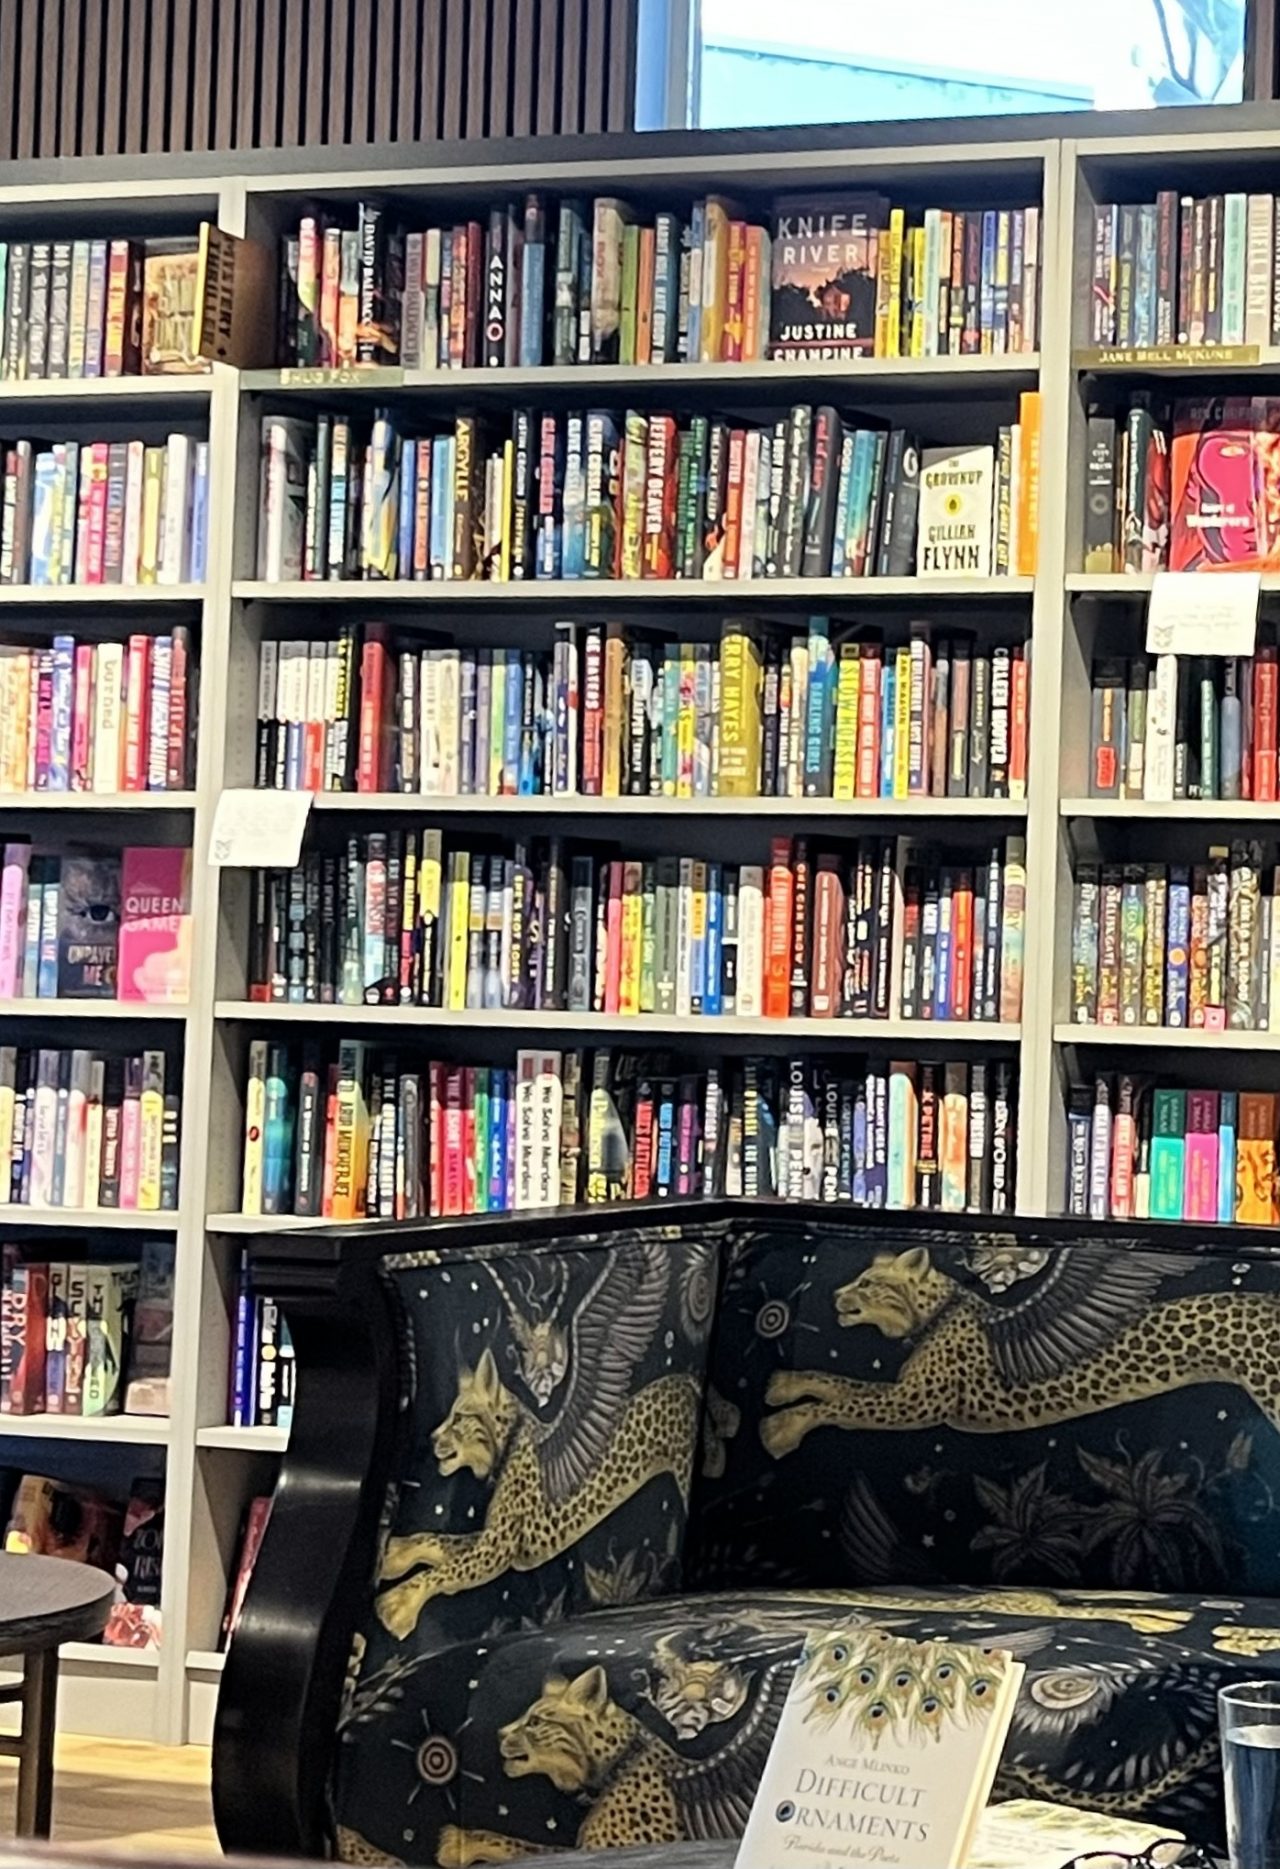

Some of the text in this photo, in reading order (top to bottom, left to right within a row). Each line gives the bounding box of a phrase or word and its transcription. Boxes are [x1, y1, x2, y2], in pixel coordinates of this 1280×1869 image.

[363, 224, 376, 266] DAVID
[778, 215, 869, 240] KNIFE
[655, 218, 670, 310] RABBIT HOLE KATE
[783, 246, 859, 265] RIVER
[1248, 226, 1266, 316] HELL BENT
[204, 243, 222, 346] THRILLER
[219, 238, 236, 338] MYSTERY
[780, 323, 858, 340] JUSTINE
[1098, 351, 1132, 363] JANE
[541, 417, 555, 455] CLIVE
[567, 419, 581, 452] CLIVE
[588, 419, 602, 452] CLIVE
[455, 419, 469, 502] ARGYLLE
[646, 416, 665, 534] JEFFERY DEAVER
[842, 438, 854, 474] GOOD
[839, 477, 851, 503] HALF
[926, 470, 983, 485] GROWNUP
[928, 526, 976, 540] GILLIAN
[924, 546, 981, 571] FLYNN
[721, 626, 742, 743] ERRY HAYES
[806, 682, 826, 774] DARLING GIRLS
[837, 666, 861, 779] SLOW HORSES
[991, 715, 1007, 765] HOOVER
[125, 896, 184, 913] QUEEN
[512, 875, 523, 909] SHE'S
[512, 913, 523, 940] NOT
[1124, 941, 1137, 965] SKY
[790, 1061, 803, 1124] LOUISE
[825, 1083, 837, 1138] LOUISE
[876, 1097, 885, 1126] MANY
[522, 1084, 533, 1201] We Solve Murders
[540, 1085, 553, 1201] We Solve Murders
[921, 1105, 933, 1158] PETRIE
[795, 1769, 927, 1808] DIFFICULT
[775, 1799, 930, 1842] ORNAMENTS
